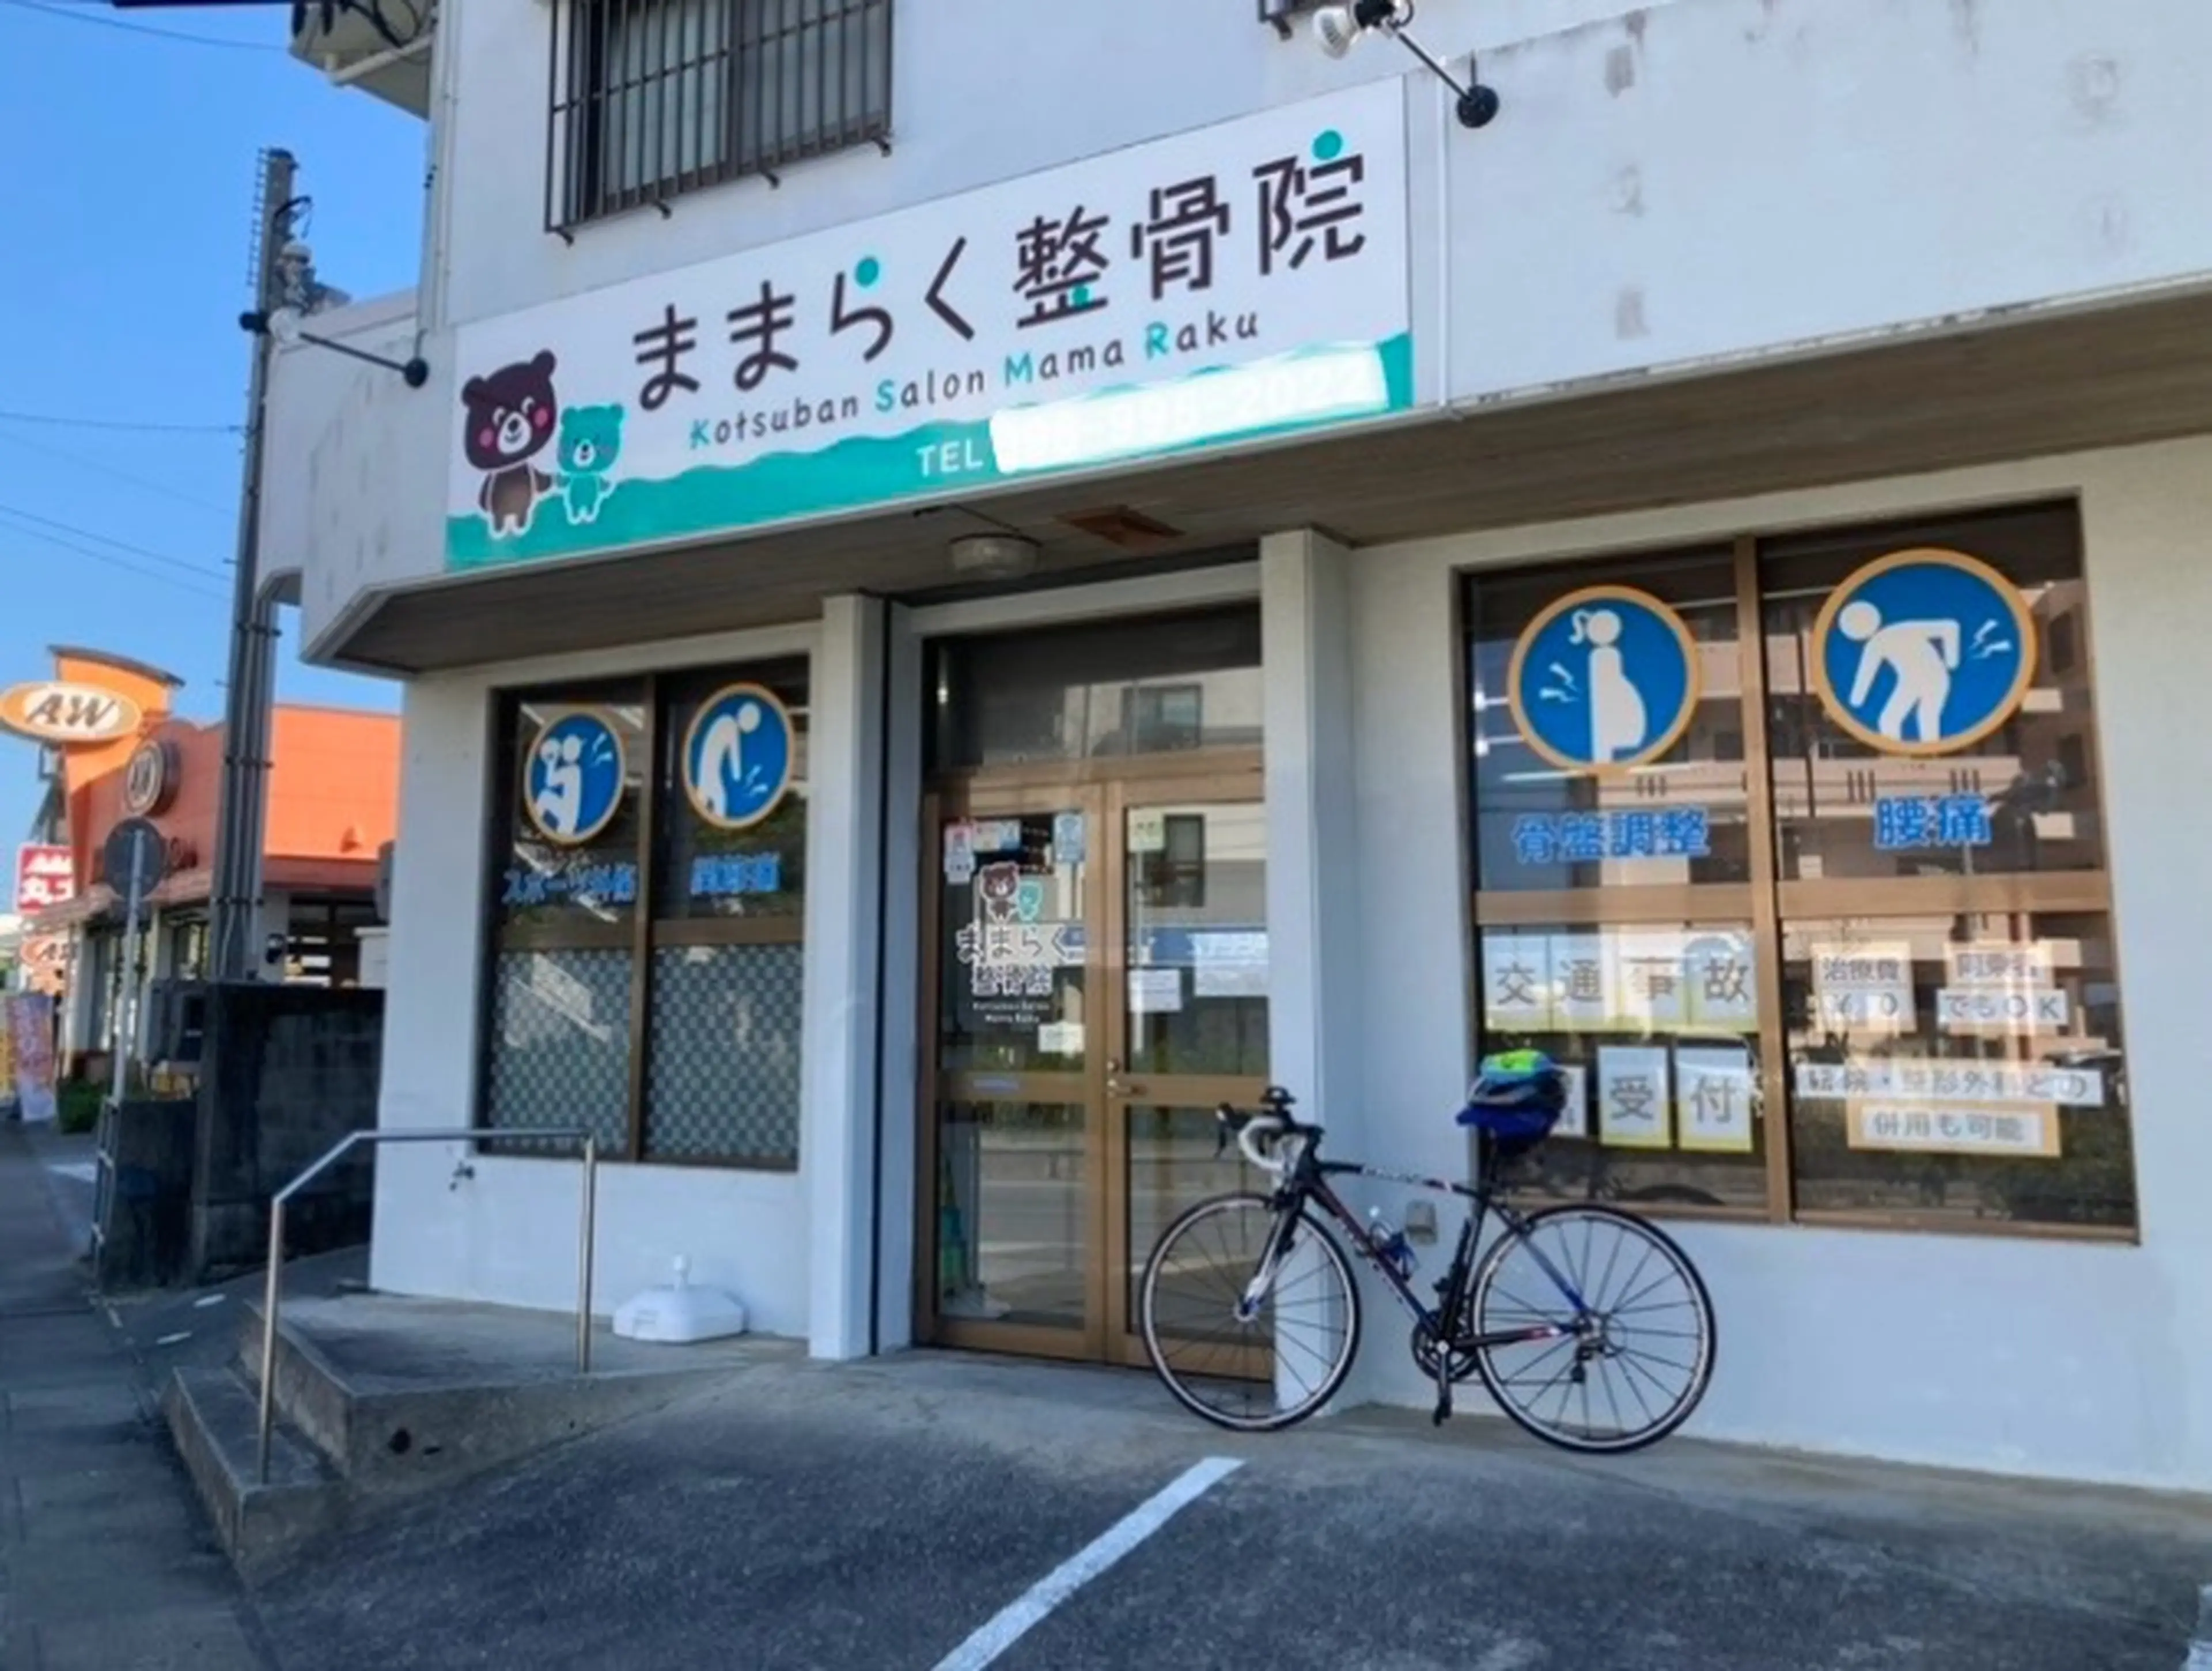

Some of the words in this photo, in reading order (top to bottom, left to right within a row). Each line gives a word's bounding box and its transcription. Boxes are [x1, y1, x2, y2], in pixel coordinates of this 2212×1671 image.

[633, 129, 1366, 411] ままらく整骨院
[690, 395, 859, 449] Kotsuban
[875, 369, 985, 412] Salon
[1004, 339, 1124, 386] Mama
[1144, 310, 1259, 361] Raku
[916, 440, 984, 478] TEL
[1511, 806, 1711, 865] 骨盤調整
[1876, 793, 1992, 848] 腰痛
[1496, 953, 1749, 1005] 交通事故
[1609, 1074, 1736, 1124] 受付
